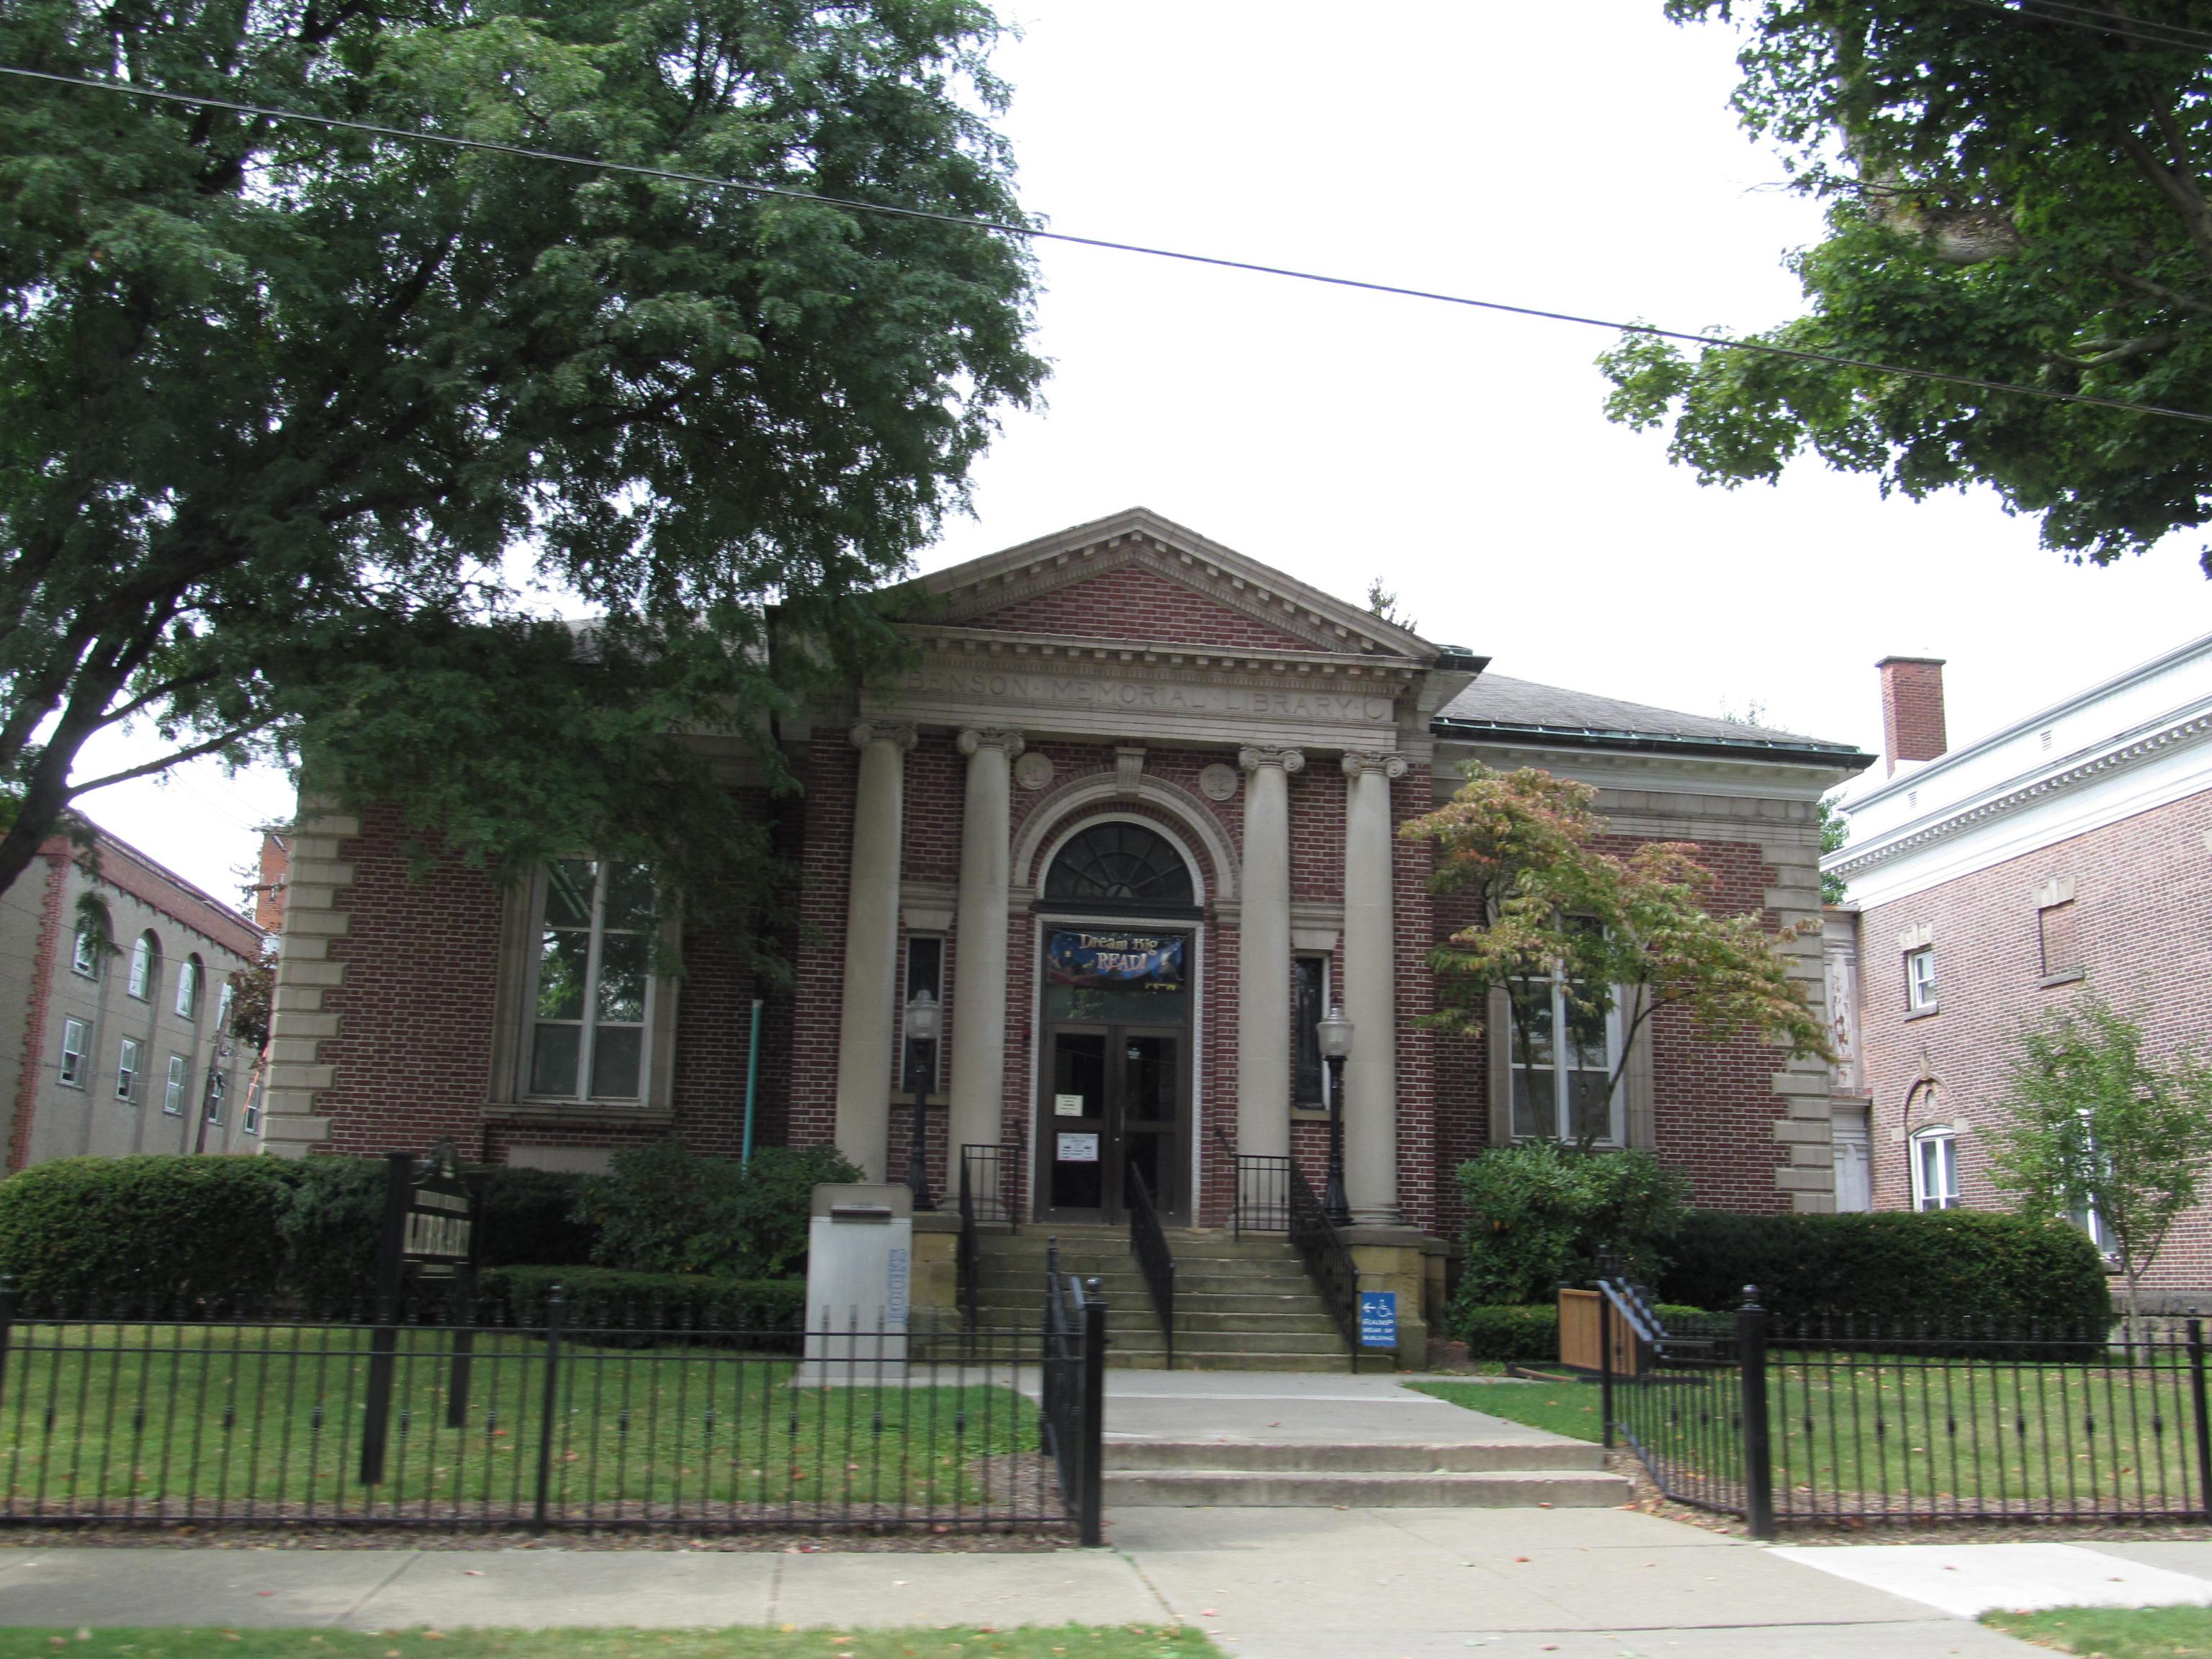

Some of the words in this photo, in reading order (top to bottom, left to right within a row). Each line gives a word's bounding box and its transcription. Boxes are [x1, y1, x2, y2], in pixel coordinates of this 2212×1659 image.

[908, 670, 1029, 697] BENSON
[1052, 679, 1205, 707] MEMORIAL
[1226, 691, 1352, 717] LIBRARY
[1079, 933, 1128, 950] Dream
[1132, 938, 1158, 956] Big
[1096, 952, 1147, 971] READ!
